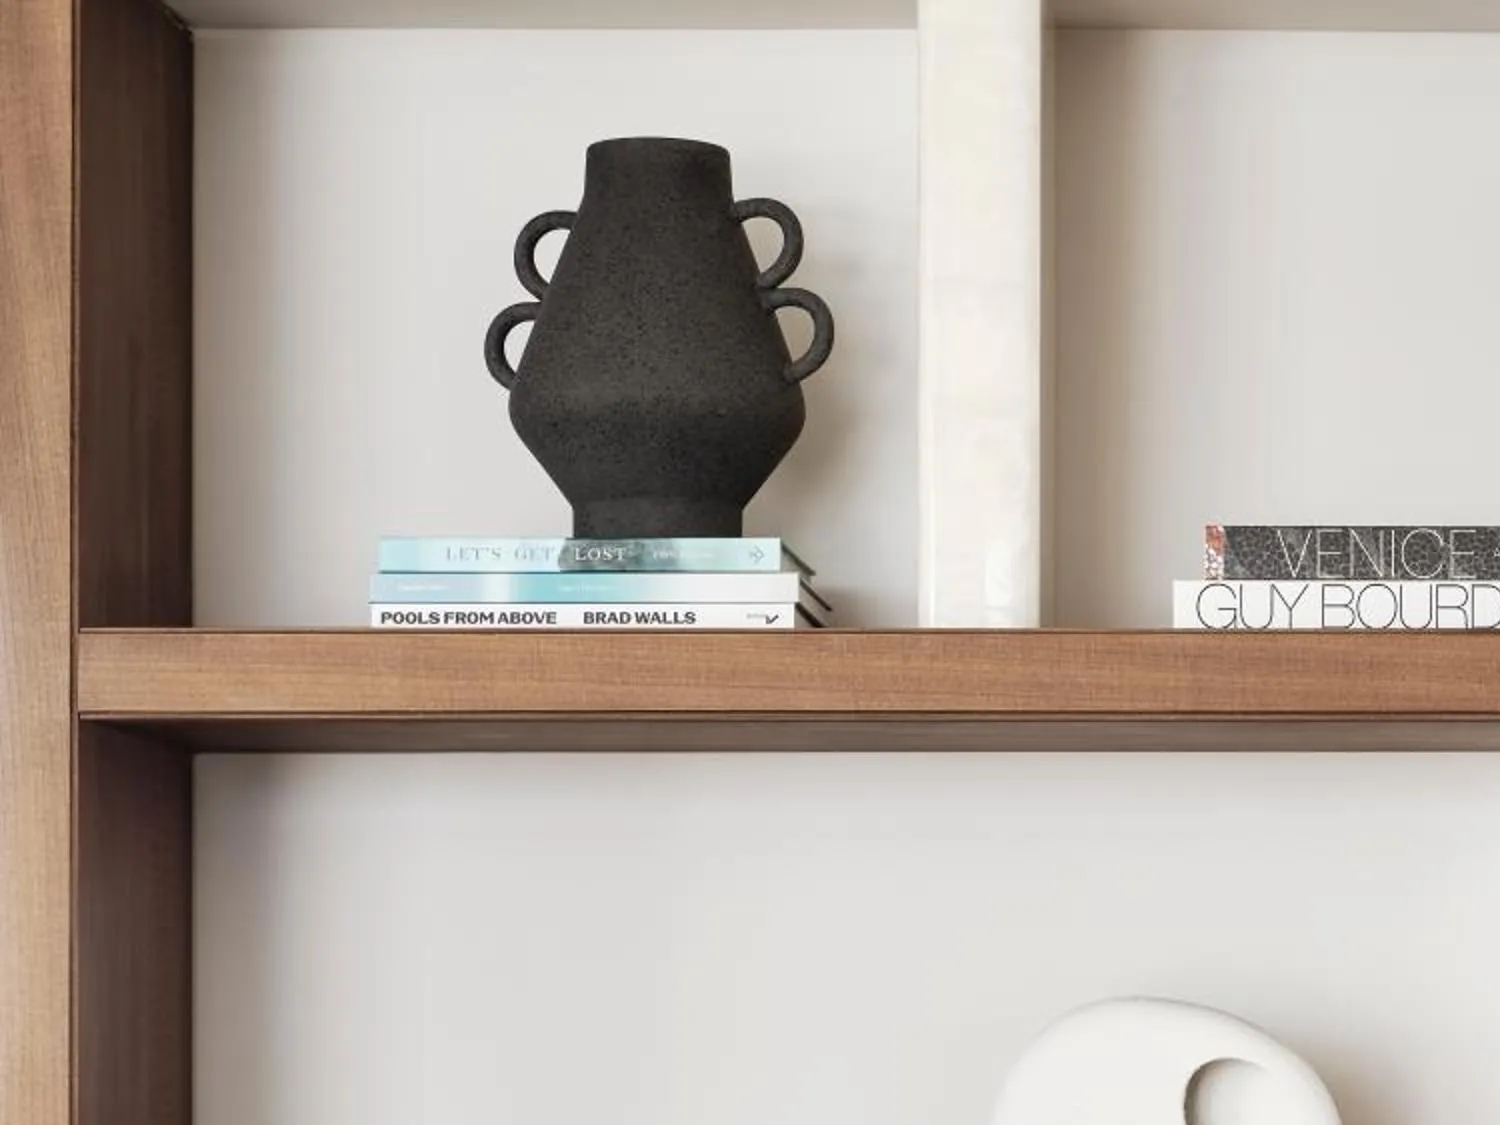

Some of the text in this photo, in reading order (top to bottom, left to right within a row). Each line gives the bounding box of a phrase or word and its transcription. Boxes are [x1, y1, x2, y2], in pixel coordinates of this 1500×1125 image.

[514, 547, 556, 561] GET
[575, 547, 627, 561] LOST
[1277, 528, 1477, 578] VENICE
[1196, 583, 1309, 629] GUY
[380, 611, 557, 625] POOLS FROM ABOVE
[583, 611, 696, 625] BRAD WALLS
